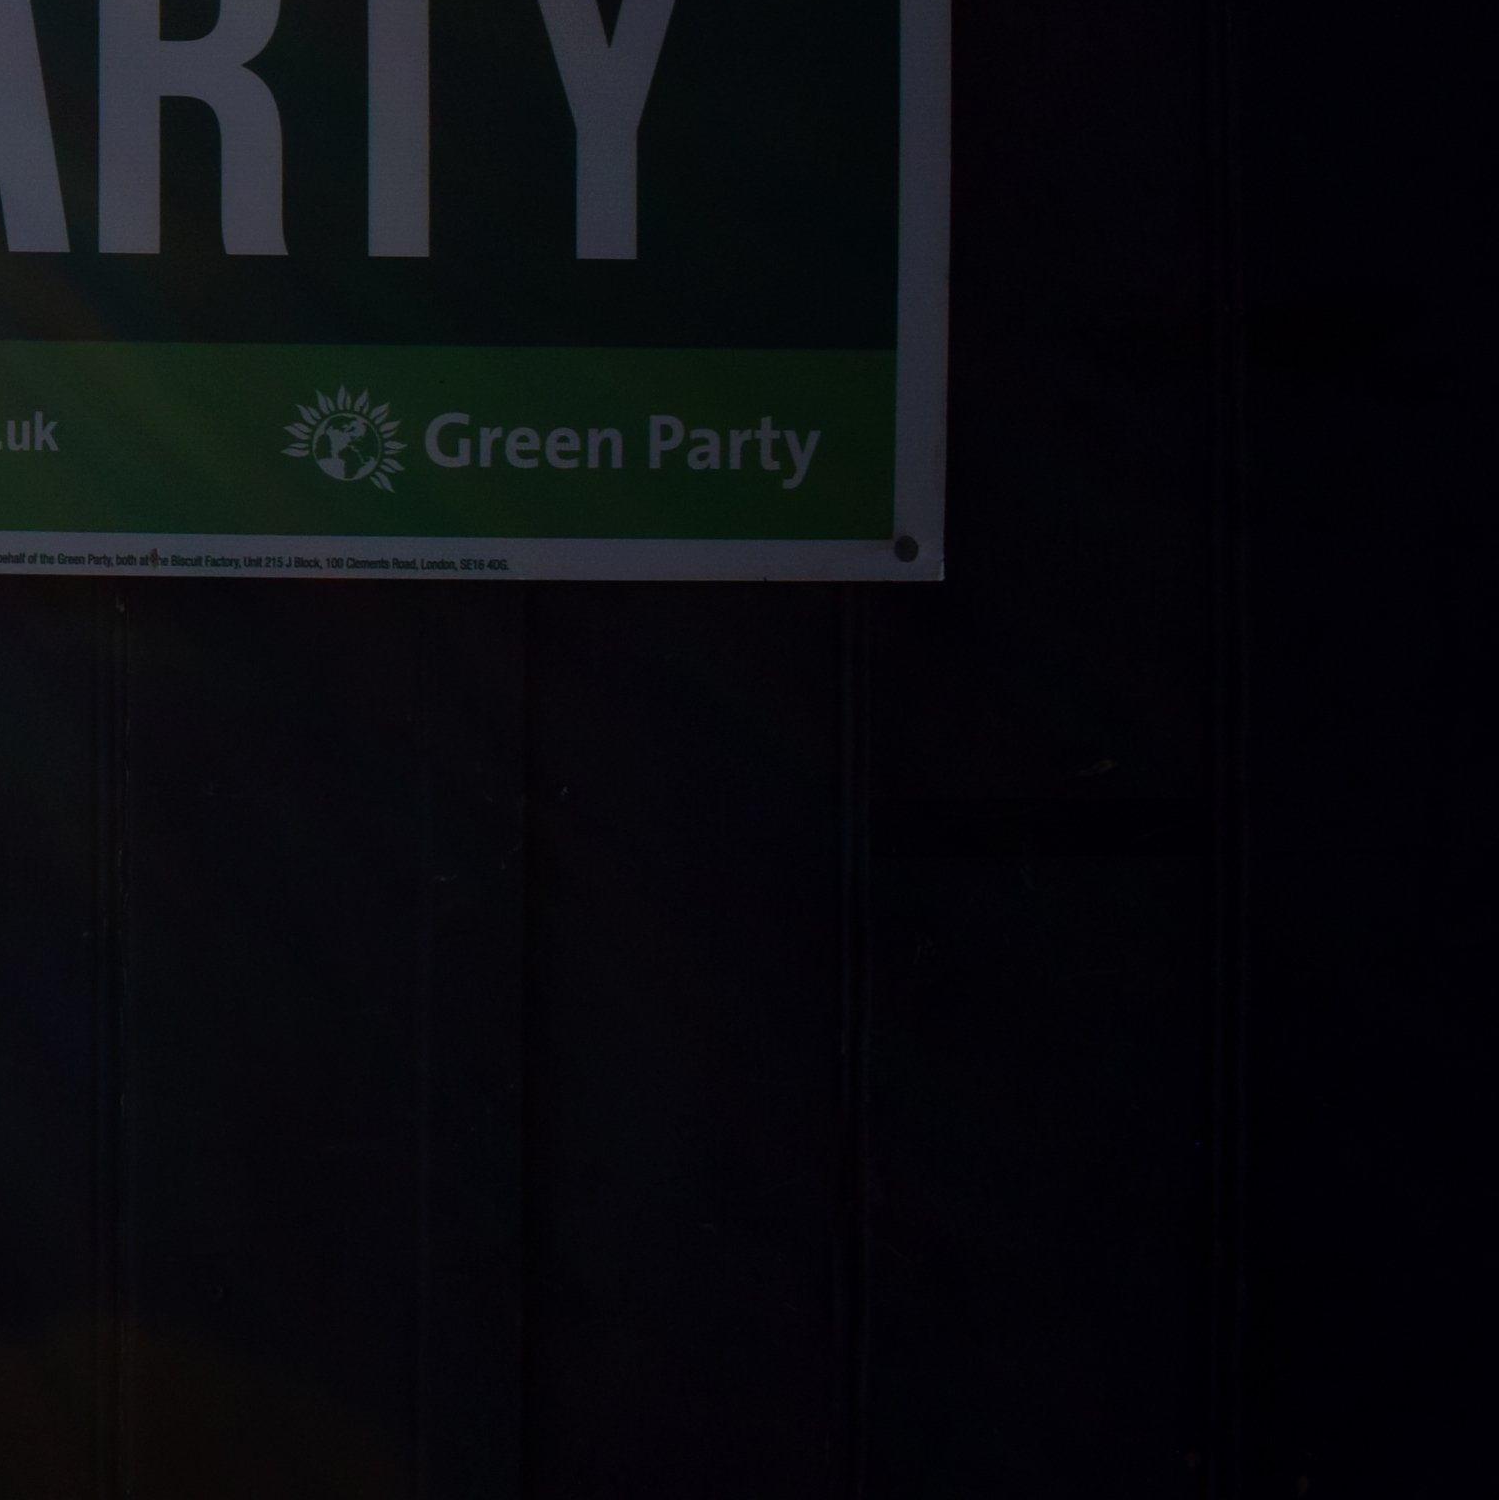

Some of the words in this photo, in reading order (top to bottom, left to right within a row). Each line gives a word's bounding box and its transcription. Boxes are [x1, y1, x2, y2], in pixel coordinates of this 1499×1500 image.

[423, 411, 623, 469] Green
[648, 414, 822, 490] Party
[28, 552, 37, 564] of
[39, 552, 55, 565] the
[57, 553, 86, 565] Green
[88, 554, 114, 568] Party,
[116, 554, 137, 566] both
[139, 555, 149, 566] at
[171, 555, 203, 567] Biscuit
[204, 555, 242, 569] Factory,
[243, 556, 263, 567] Unit
[264, 556, 284, 568] 215
[285, 557, 292, 568] J
[294, 556, 323, 569] Block,
[326, 557, 344, 569] 100
[346, 557, 390, 569] Clements
[392, 558, 419, 570] Road,
[421, 559, 458, 571] London,
[460, 558, 485, 571] SE16
